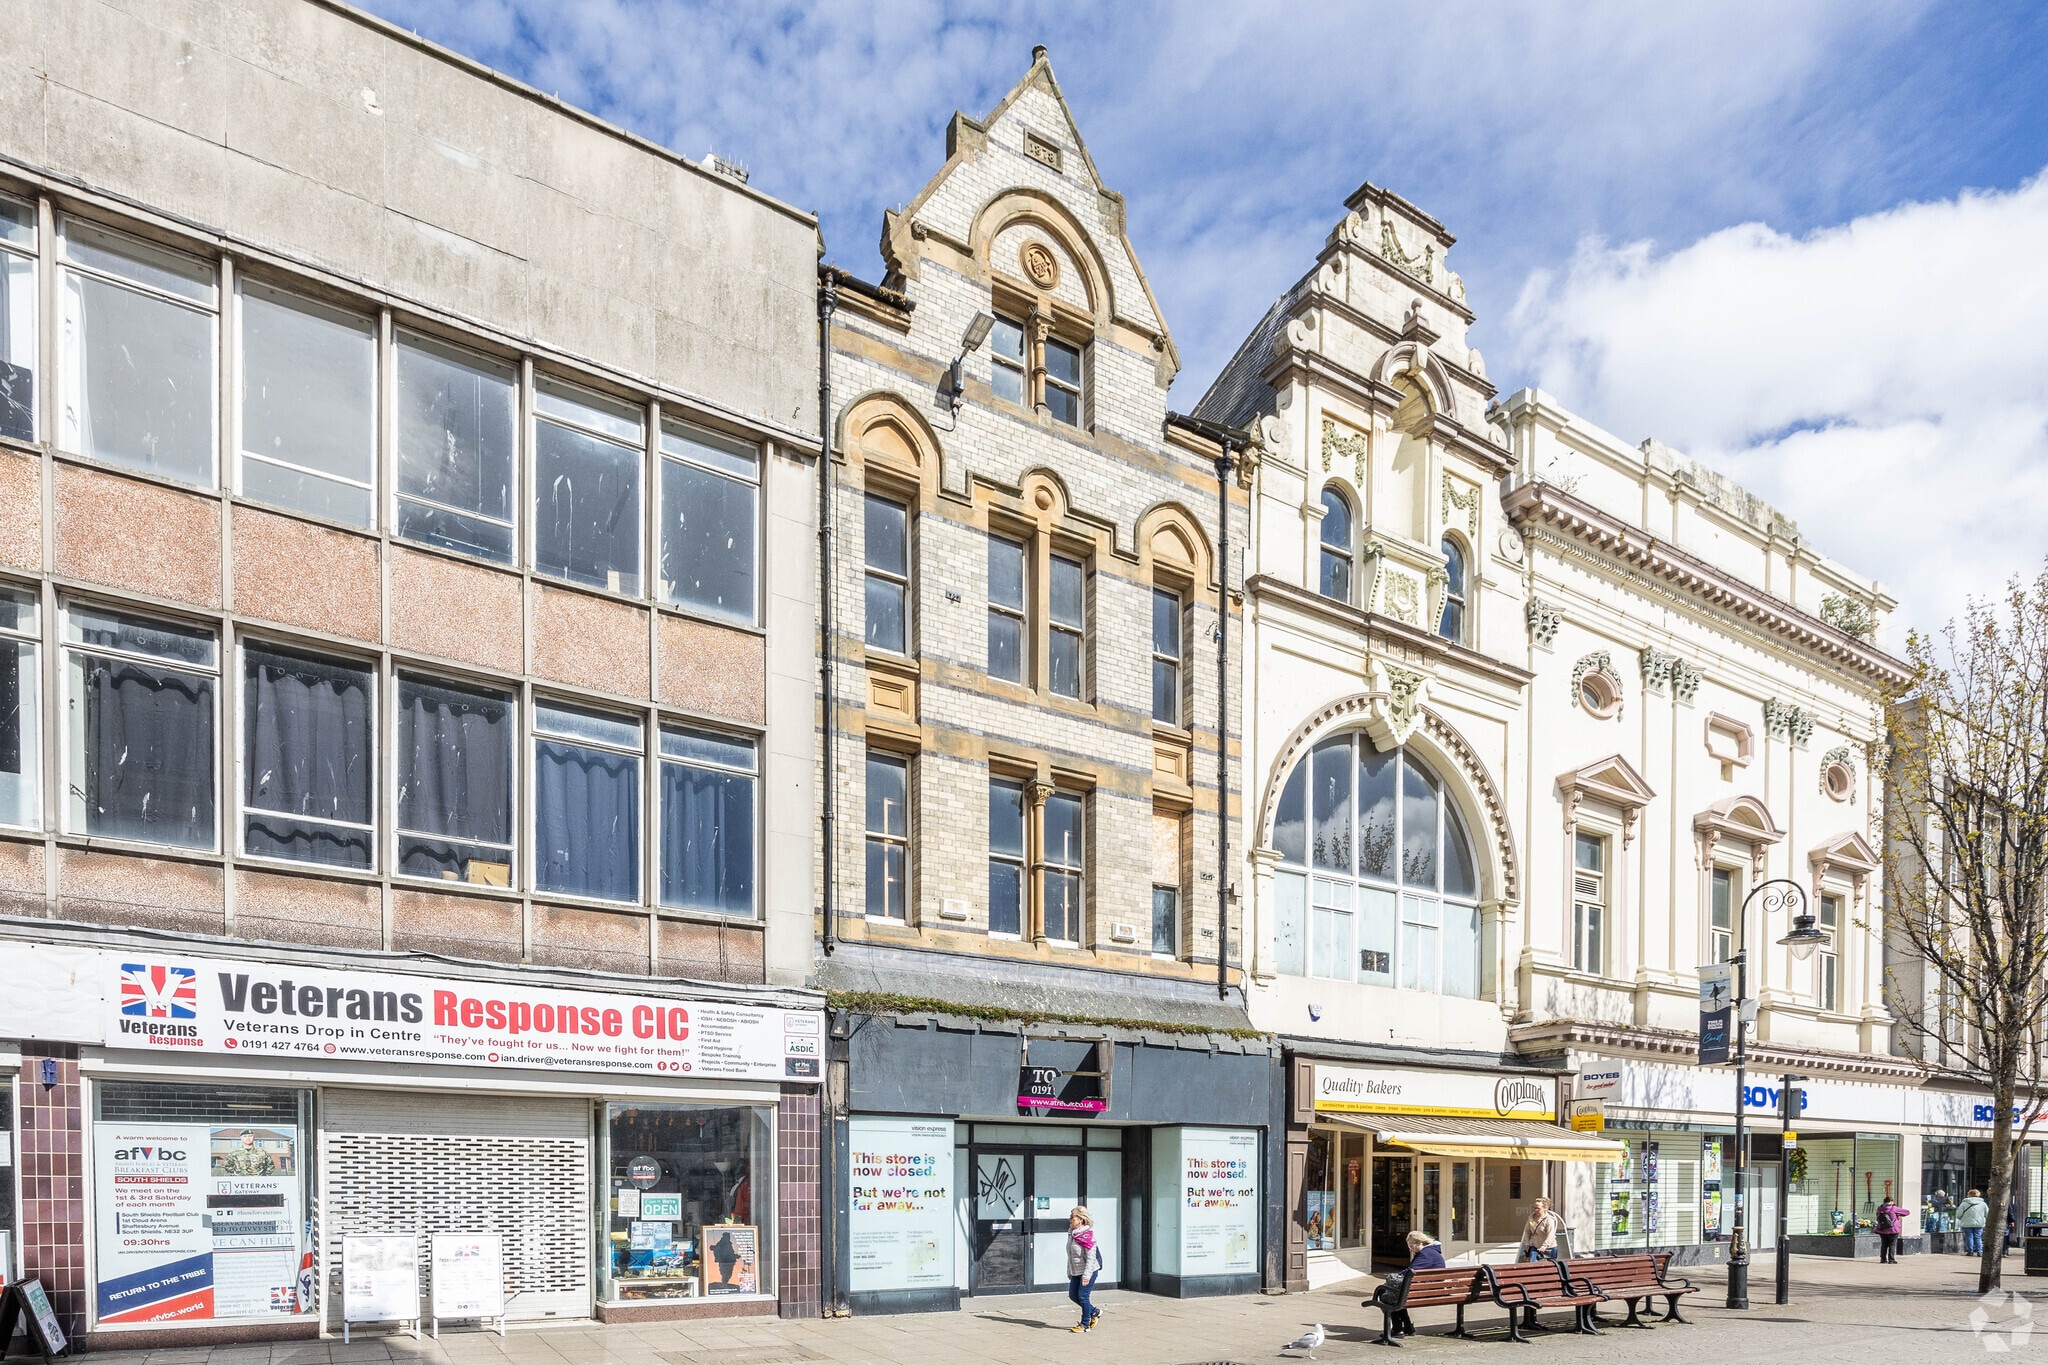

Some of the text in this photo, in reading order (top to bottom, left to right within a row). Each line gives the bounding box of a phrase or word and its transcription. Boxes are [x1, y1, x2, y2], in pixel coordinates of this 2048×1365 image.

[217, 972, 689, 1041] Veterans Response CIC
[119, 1019, 198, 1037] Veterans
[223, 1019, 422, 1041] Veterans Drop in Centre
[149, 1034, 204, 1048] Response
[488, 1036, 524, 1050] fought
[527, 1040, 543, 1049] for
[571, 1042, 594, 1052] Now
[597, 1045, 612, 1053] we
[614, 1044, 637, 1056] fight
[640, 1046, 655, 1055] for
[241, 1040, 653, 1070] 0191 427 4764 www.veteransresponse.com ian.driver@veteransresponse.com
[789, 1045, 814, 1053] ASDIC
[1033, 1070, 1056, 1083] TO
[1583, 1072, 1620, 1081] BOYES
[1322, 1076, 1402, 1096] Quality Bakers
[1494, 1076, 1546, 1117] Cooplands
[1743, 1086, 1808, 1110] BOYS
[1973, 1104, 2020, 1124] BOS
[852, 1152, 935, 1164] This store is
[1187, 1158, 1247, 1168] This store is
[853, 1166, 936, 1176] now closed.
[1187, 1169, 1247, 1178] now closed.
[853, 1186, 878, 1198] But
[924, 1187, 946, 1198] not
[1187, 1187, 1205, 1196] But
[1238, 1187, 1254, 1196] not
[644, 1204, 678, 1215] OPEN
[853, 1199, 924, 1212] far away...
[1187, 1198, 1239, 1209] far away...
[123, 1239, 171, 1247] 09:30hrs
[229, 1238, 256, 1246] CAN
[109, 1268, 207, 1301] RETURN TO THE TRIBE
